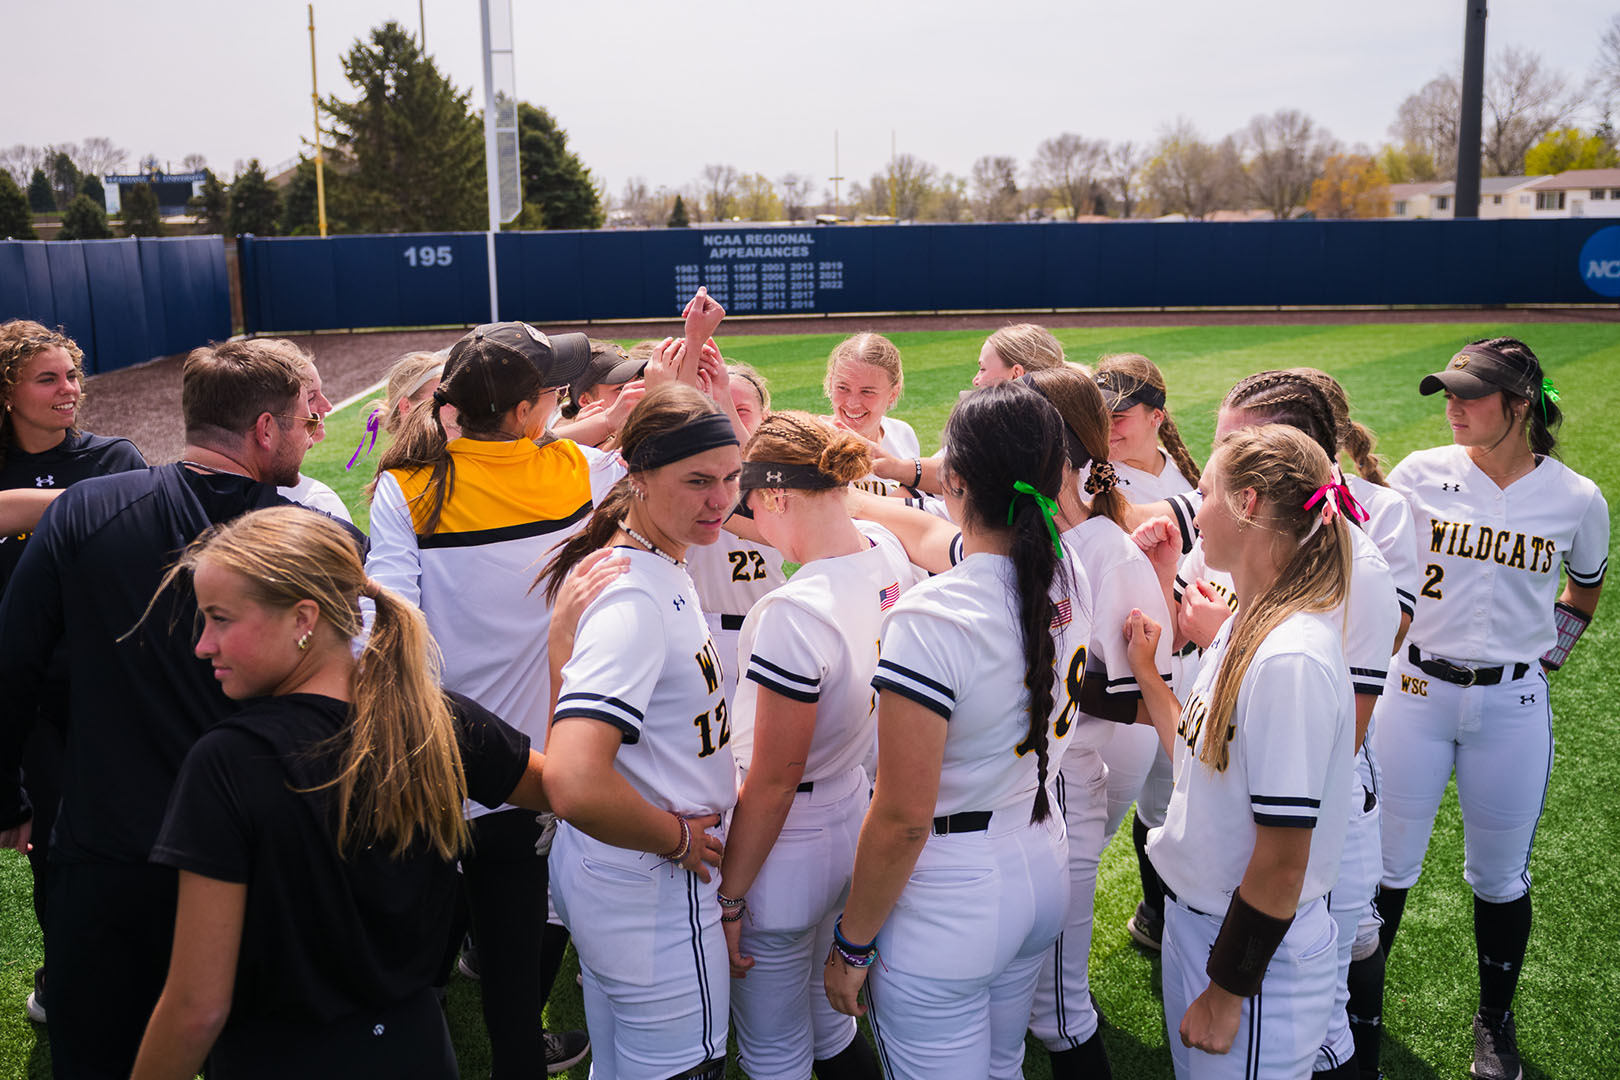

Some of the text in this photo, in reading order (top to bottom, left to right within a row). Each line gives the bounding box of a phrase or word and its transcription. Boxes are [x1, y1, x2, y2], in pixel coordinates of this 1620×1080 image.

[703, 233, 815, 246] NCAA REGIONAL
[403, 246, 453, 266] 195
[709, 246, 809, 258] APPEARANCES
[762, 281, 786, 291] 2010
[819, 280, 843, 289] 2022
[762, 291, 786, 301] 2011
[762, 300, 786, 310] 2012
[1430, 518, 1556, 574] WILDCATS
[727, 549, 767, 583] 22
[1420, 563, 1445, 600] 2
[1401, 673, 1429, 697] WSC
[694, 696, 731, 758] 12
